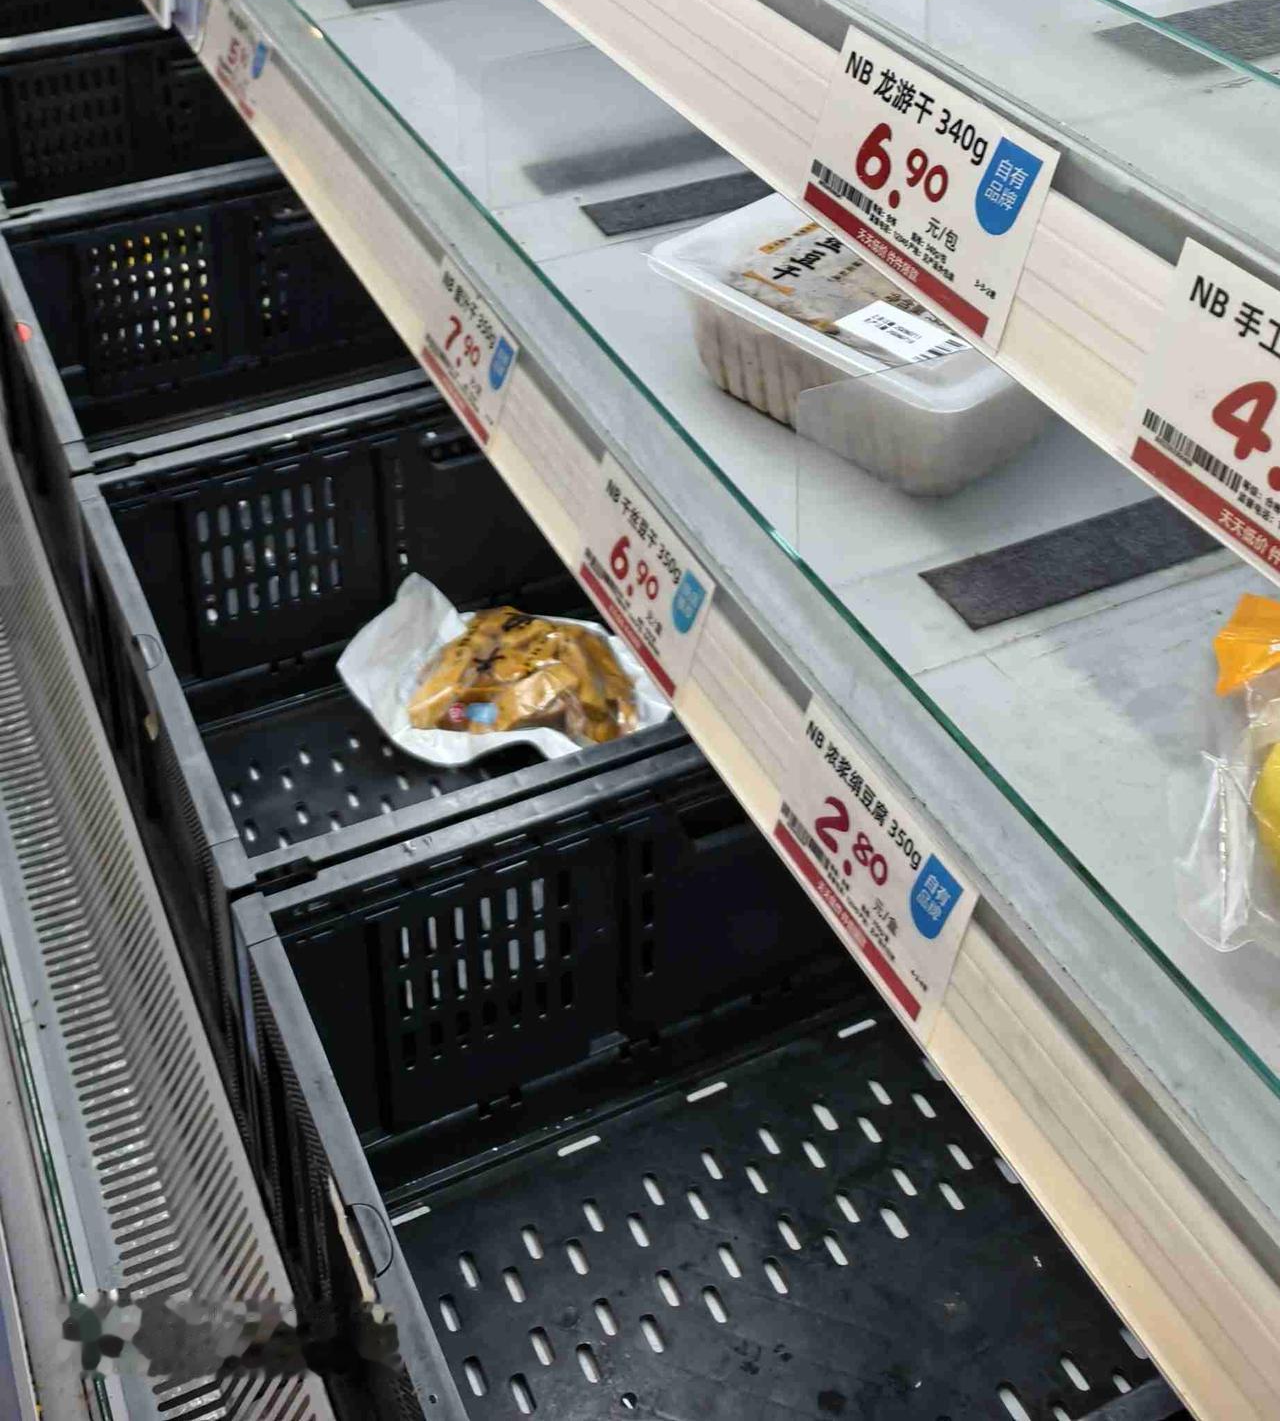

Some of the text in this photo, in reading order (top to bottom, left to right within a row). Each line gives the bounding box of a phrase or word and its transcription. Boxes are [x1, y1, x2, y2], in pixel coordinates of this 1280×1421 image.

[845, 51, 988, 166] NB 龙游干 340g
[855, 122, 949, 209] 6.90
[994, 158, 1030, 194] 自有
[984, 180, 1021, 212] 品牌
[925, 217, 959, 252] 元/包
[1189, 275, 1230, 319] NB
[445, 315, 481, 368] 7.90
[610, 536, 659, 600] 6.90
[657, 543, 682, 585] 350g
[806, 720, 825, 749] NB
[887, 819, 922, 871] 350g
[815, 796, 889, 886] 2.80
